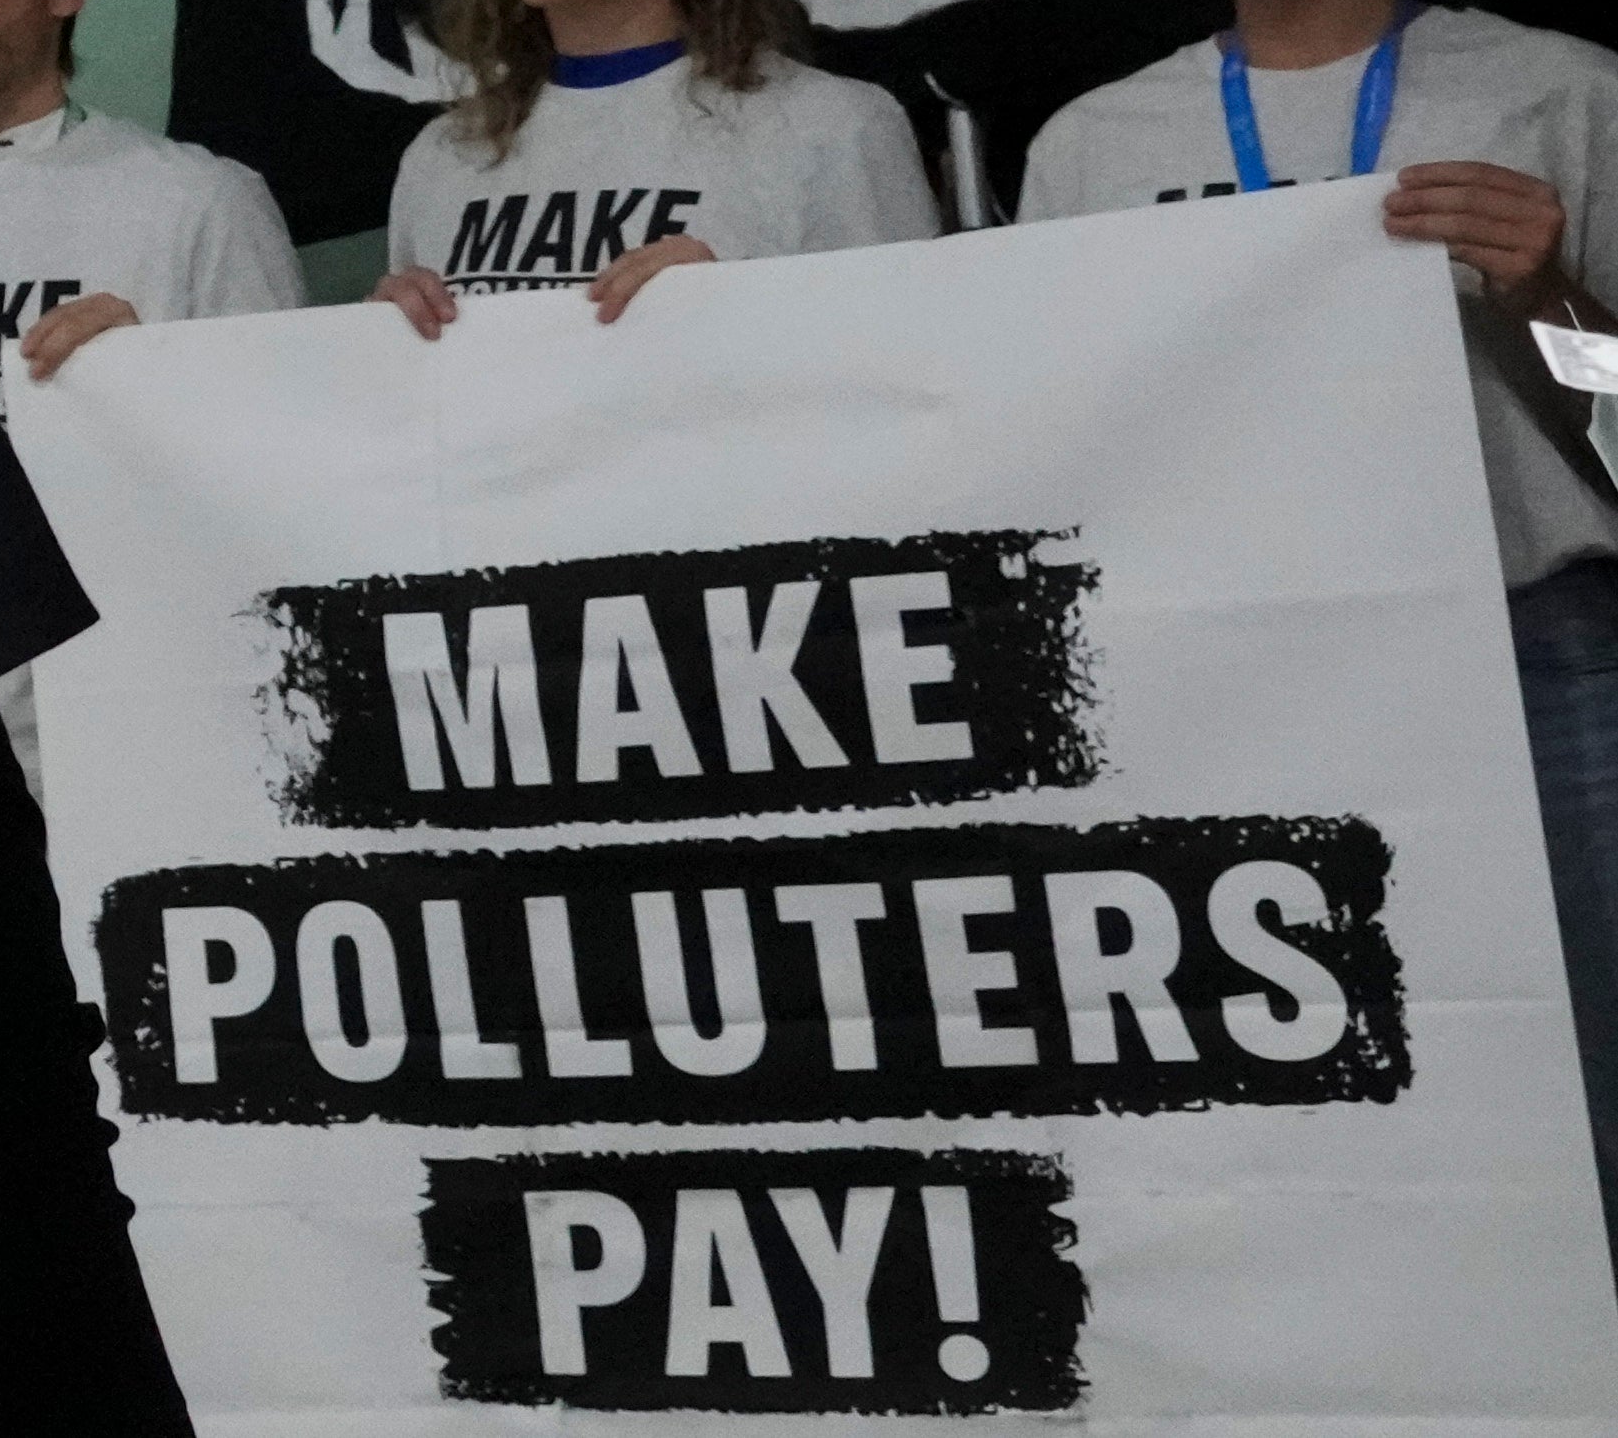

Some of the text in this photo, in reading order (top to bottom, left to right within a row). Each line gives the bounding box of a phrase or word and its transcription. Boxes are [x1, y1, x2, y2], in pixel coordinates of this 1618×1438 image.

[381, 570, 977, 791] MAKE
[160, 860, 1353, 1086] POLLUTERS
[521, 1185, 990, 1383] PAY!
